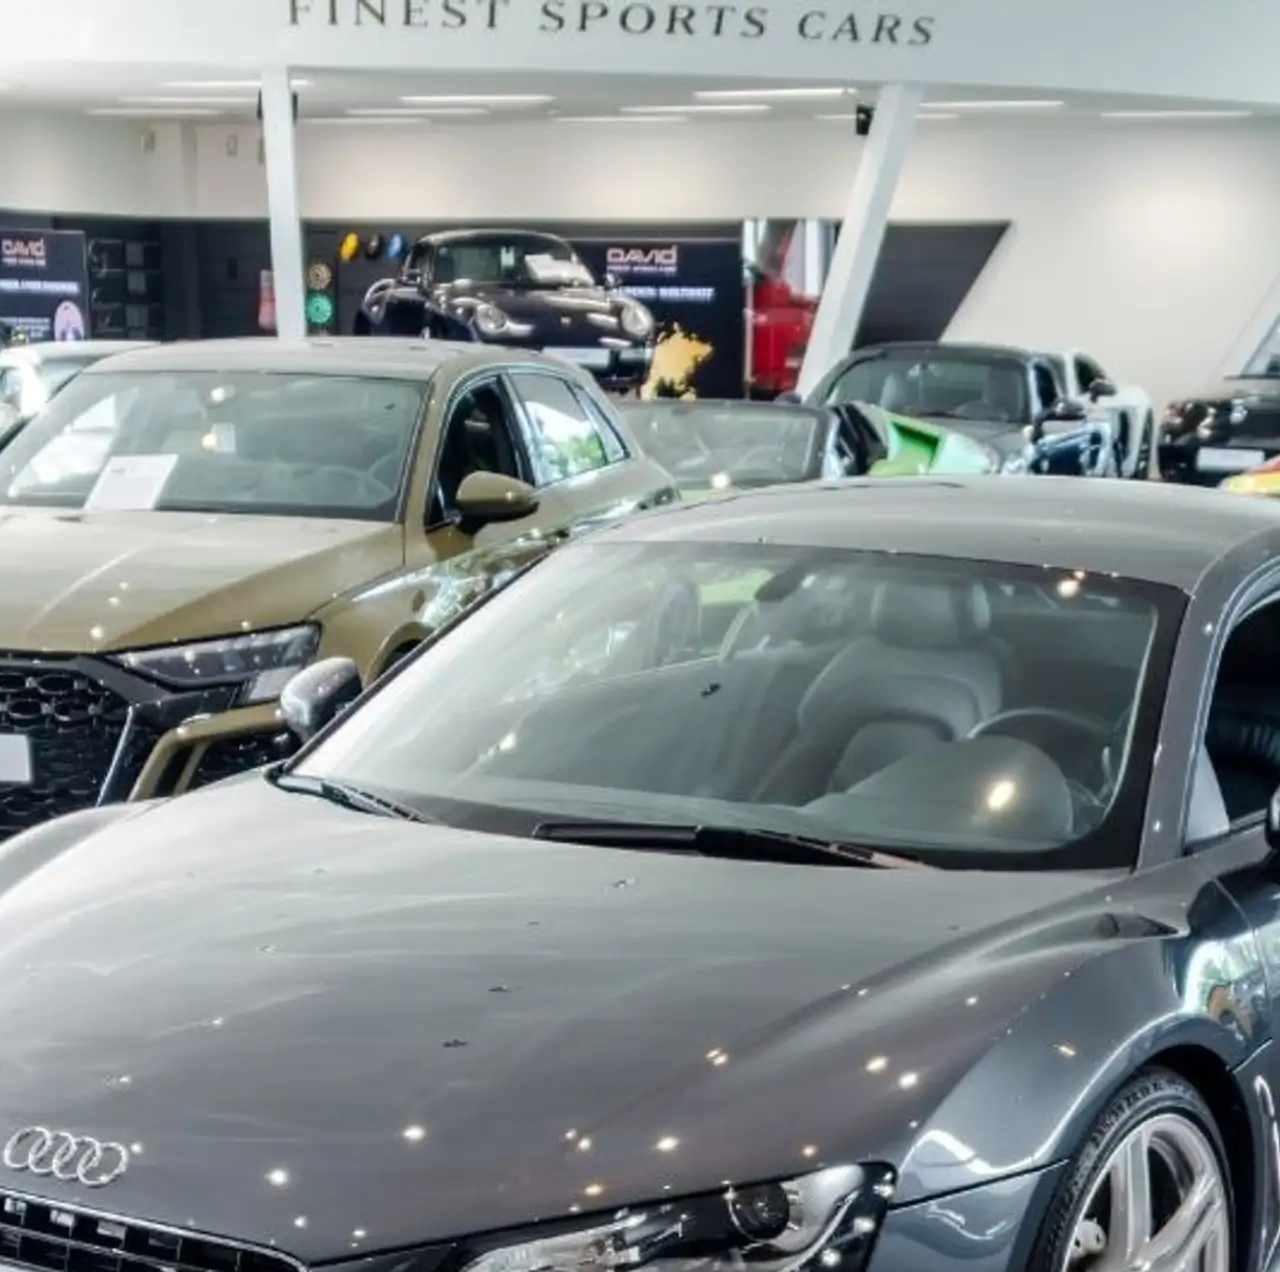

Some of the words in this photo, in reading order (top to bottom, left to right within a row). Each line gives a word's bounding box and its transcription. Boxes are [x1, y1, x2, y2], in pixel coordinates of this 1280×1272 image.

[288, 0, 510, 29] FINEST
[538, 0, 769, 38] SPORTS
[797, 10, 937, 46] CARS
